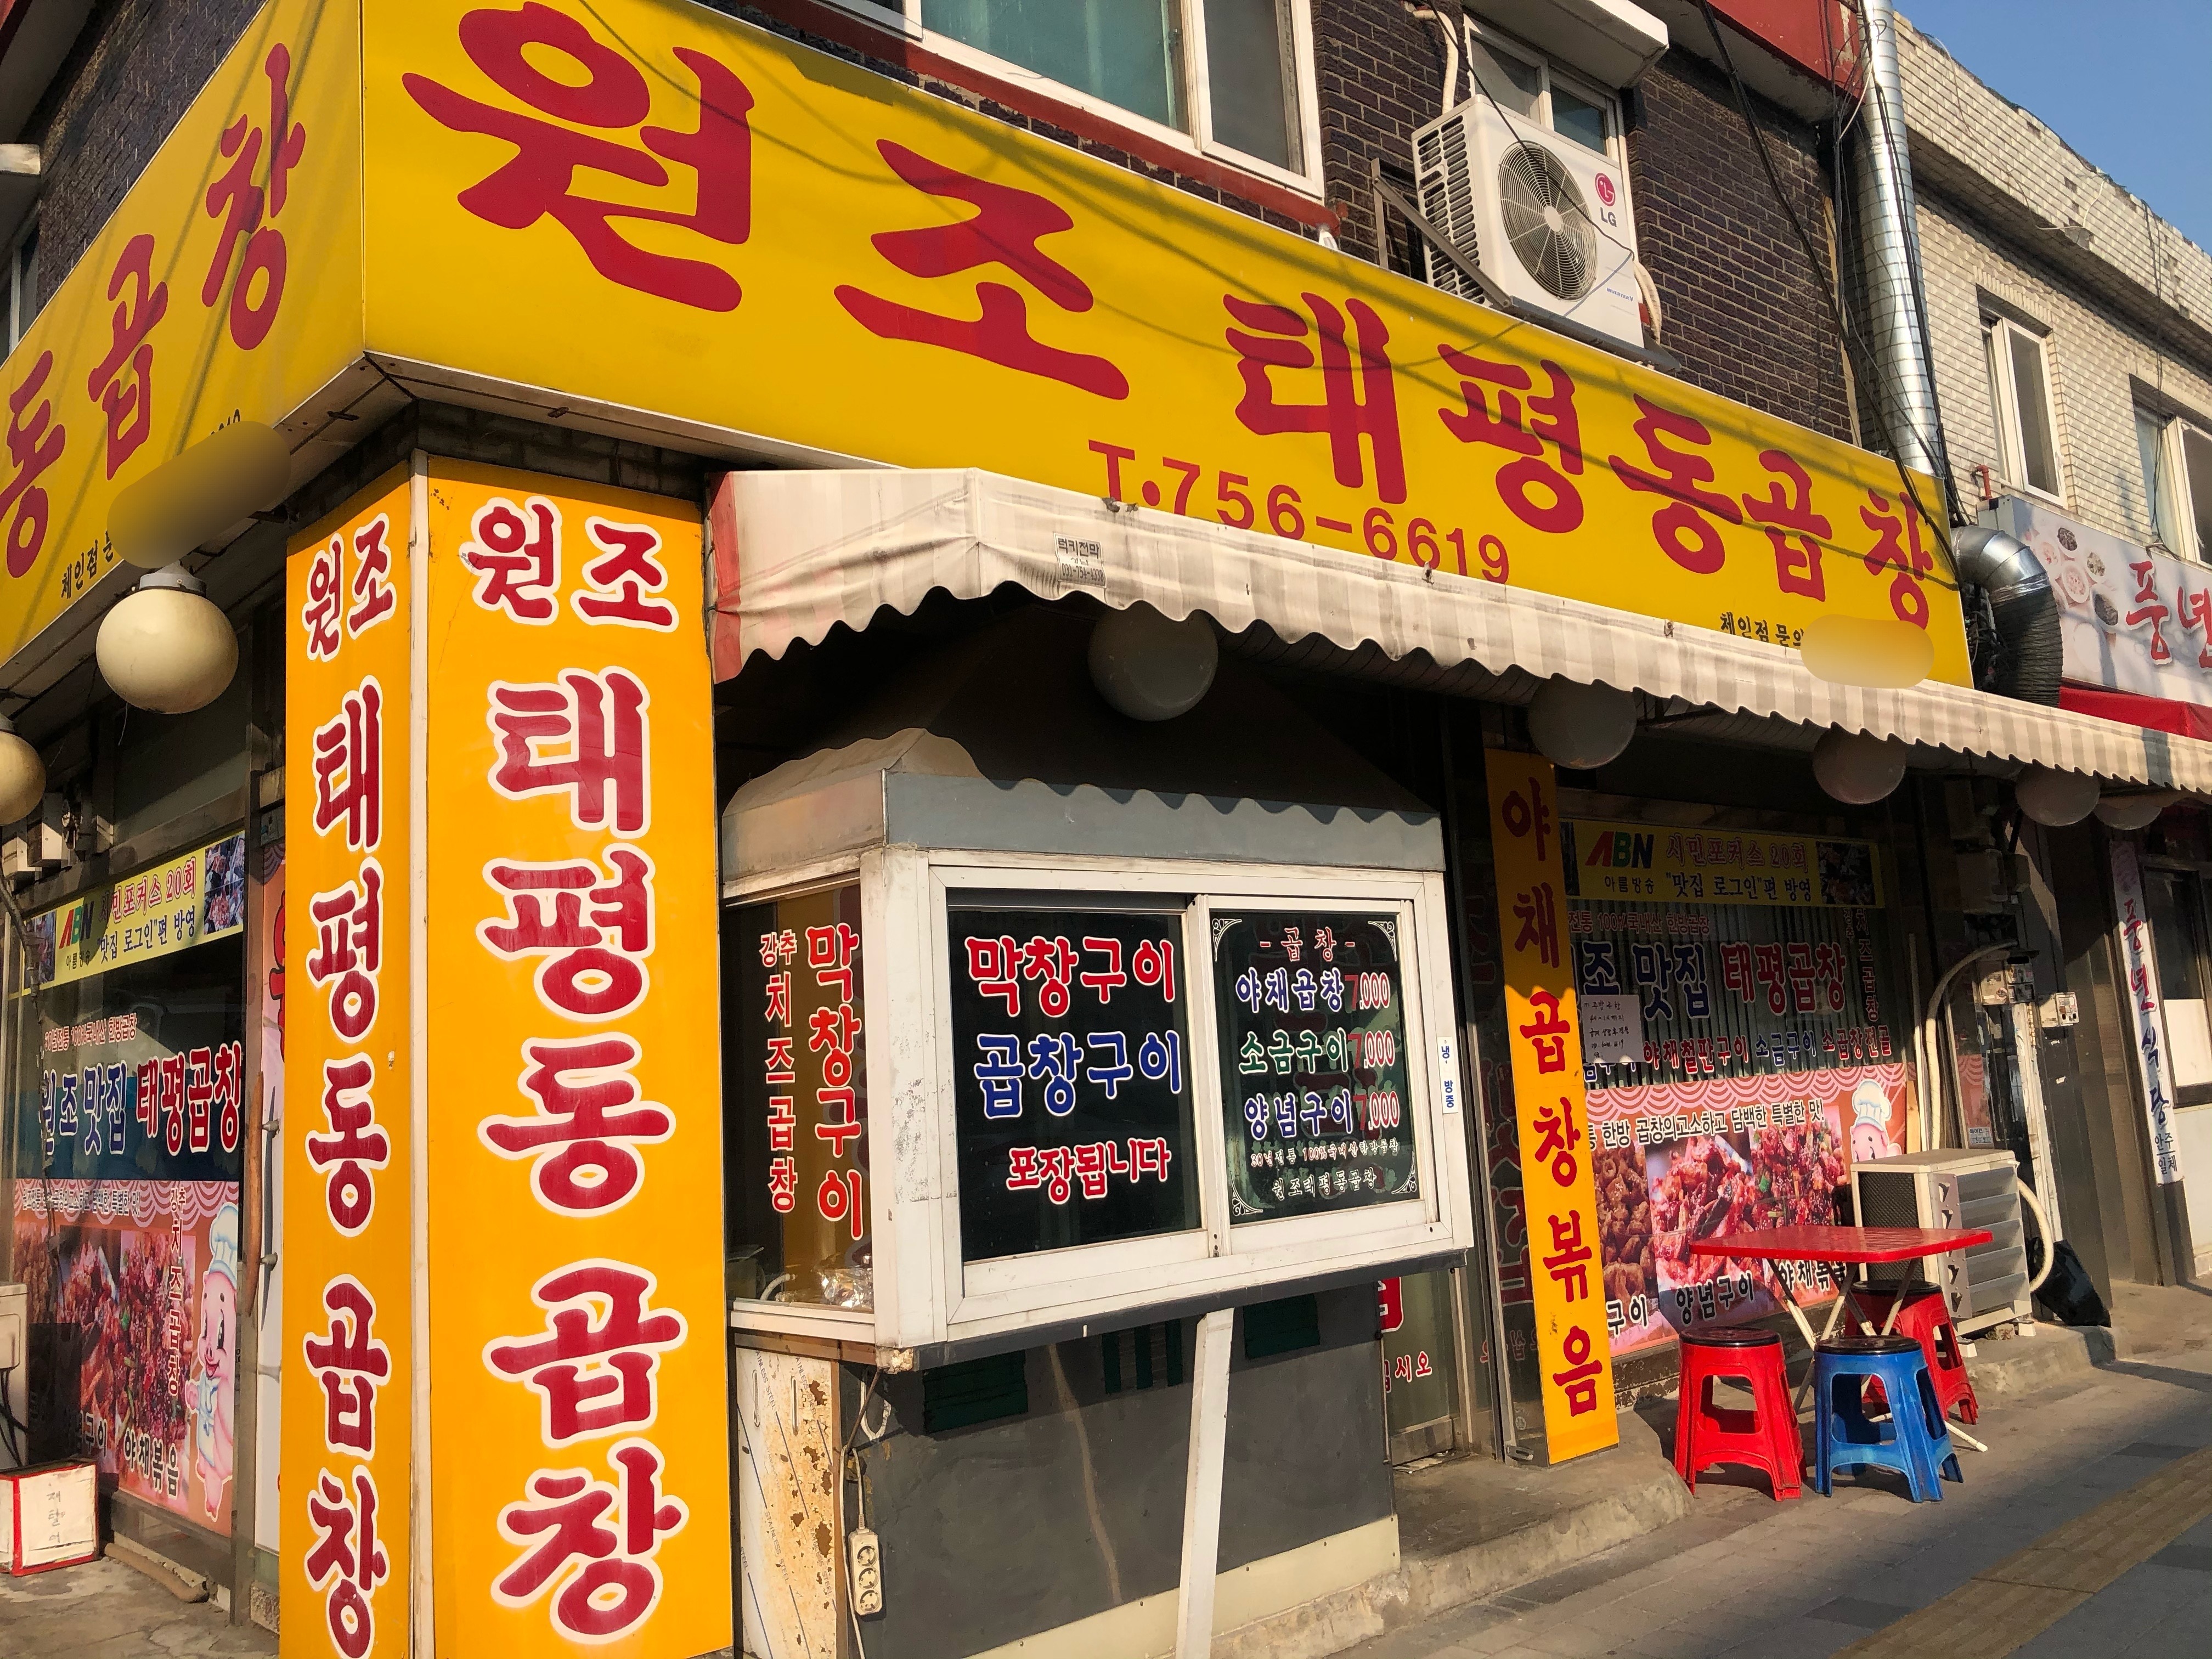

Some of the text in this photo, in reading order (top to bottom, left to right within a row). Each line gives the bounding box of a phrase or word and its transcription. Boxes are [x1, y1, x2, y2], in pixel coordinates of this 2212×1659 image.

[402, 0, 1130, 400] 원조
[1600, 206, 1617, 228] LG
[460, 495, 679, 633] 원조
[1057, 537, 1099, 560] 럭키천막
[303, 512, 398, 662] 원조
[1585, 831, 1655, 869] ABN
[1666, 832, 1809, 872] 시민포커스 20회
[165, 856, 196, 902] 20회
[1784, 877, 1812, 902] 방영
[59, 900, 94, 949] ABN
[173, 905, 196, 941] 방영
[760, 929, 798, 968] 강추
[964, 934, 1175, 1018] 막창구이
[1235, 966, 1345, 1014] 야채곱창
[1632, 941, 1711, 1022] 맛집
[1720, 940, 1847, 1017] 태평곱창
[973, 1029, 1182, 1120] 곱창구이
[1239, 1026, 1349, 1075] 소금구이
[1643, 1034, 1749, 1074] 야채철판구이
[1755, 1030, 1817, 1066] 소금구이
[83, 1059, 128, 1155] 맛집
[136, 1039, 242, 1156] 태평곱창
[765, 970, 798, 1214] 치즈곱창
[805, 922, 864, 1241] 막창구이
[1244, 1087, 1354, 1141] 양념구이
[1731, 1105, 1767, 1131] 담백한
[1771, 1101, 1806, 1126] 특별한
[303, 675, 392, 1658] 태평동곱창
[476, 665, 689, 1645] 태평동곱창
[2154, 1132, 2174, 1152] 안주
[2158, 1154, 2177, 1175] 일체
[1006, 1137, 1172, 1205] 포장됩니다
[170, 1186, 187, 1218] 강추
[166, 1217, 184, 1398] 치즈곱창
[1675, 1270, 1755, 1327] 양념구이
[766, 1386, 776, 1410] STEEL
[123, 1426, 179, 1500] 야채볶음
